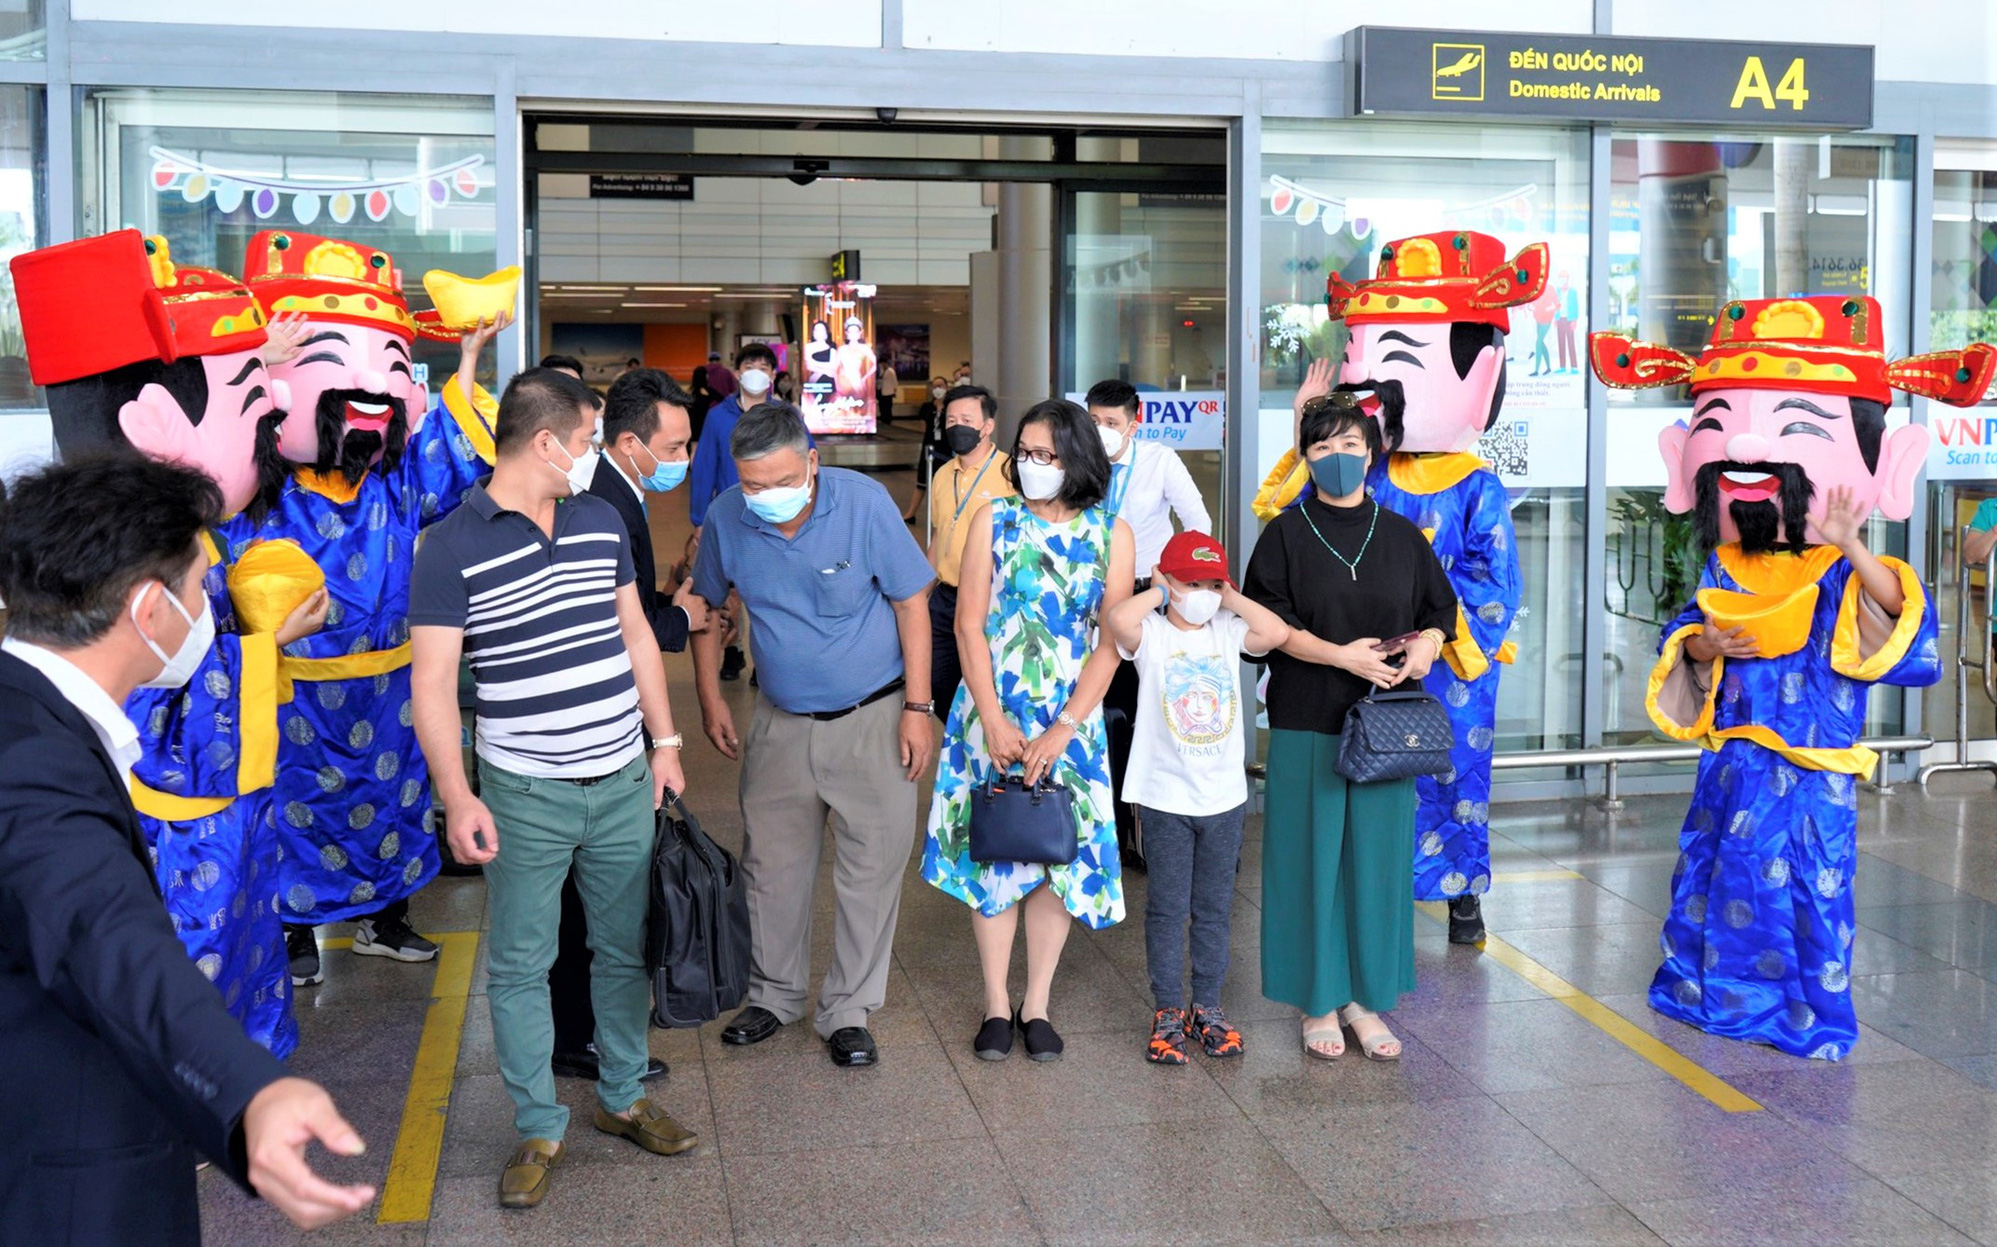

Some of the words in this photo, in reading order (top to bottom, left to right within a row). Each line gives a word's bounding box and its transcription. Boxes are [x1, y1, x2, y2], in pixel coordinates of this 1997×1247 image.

[1730, 56, 1809, 110] A4
[1509, 80, 1591, 99] Domestic
[1594, 83, 1661, 102] Arrivals
[1147, 428, 1159, 439] to
[1163, 426, 1187, 441] Pay
[1946, 450, 1980, 465] Scan
[1177, 743, 1222, 758] VERSACE
